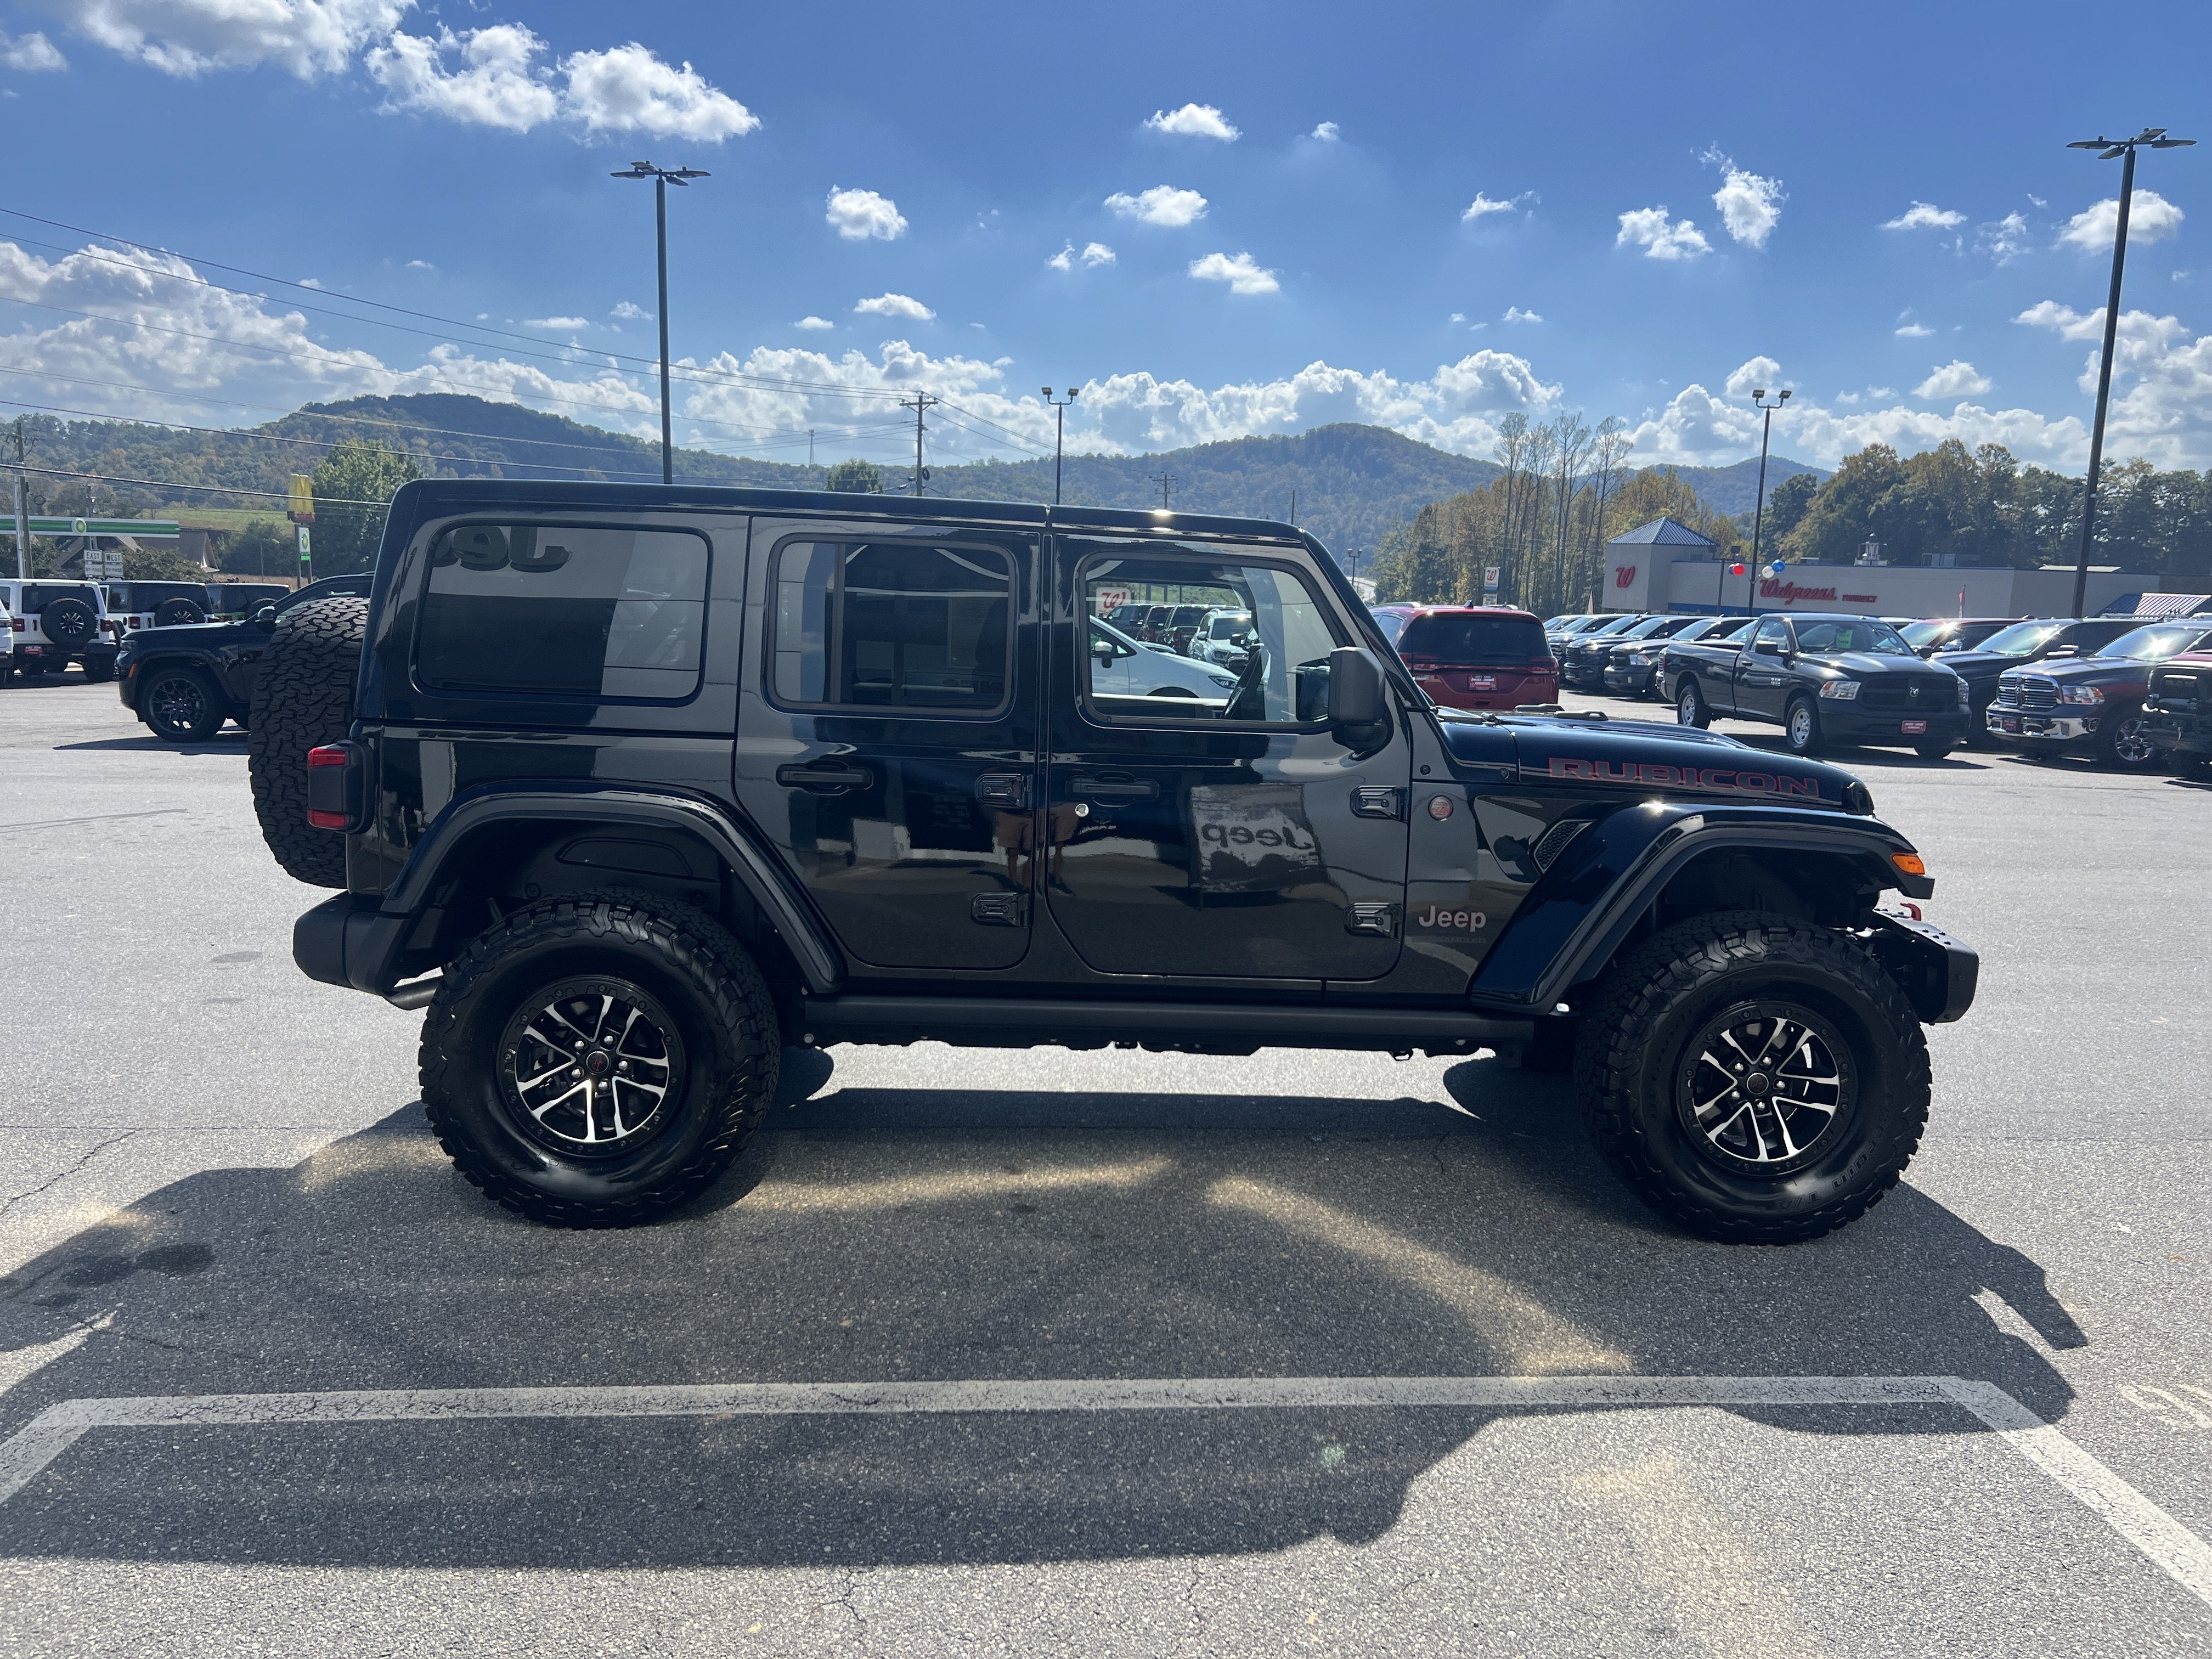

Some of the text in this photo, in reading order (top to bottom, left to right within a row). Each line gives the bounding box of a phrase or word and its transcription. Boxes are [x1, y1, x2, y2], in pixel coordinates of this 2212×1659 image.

[86, 551, 100, 560] EAST
[1487, 569, 1497, 581] W
[1616, 566, 1636, 588] W
[1102, 591, 1126, 609] W
[1759, 578, 1837, 605] Walgreens
[1549, 758, 1819, 797] RUBICON
[1418, 905, 1487, 932] Jeep
